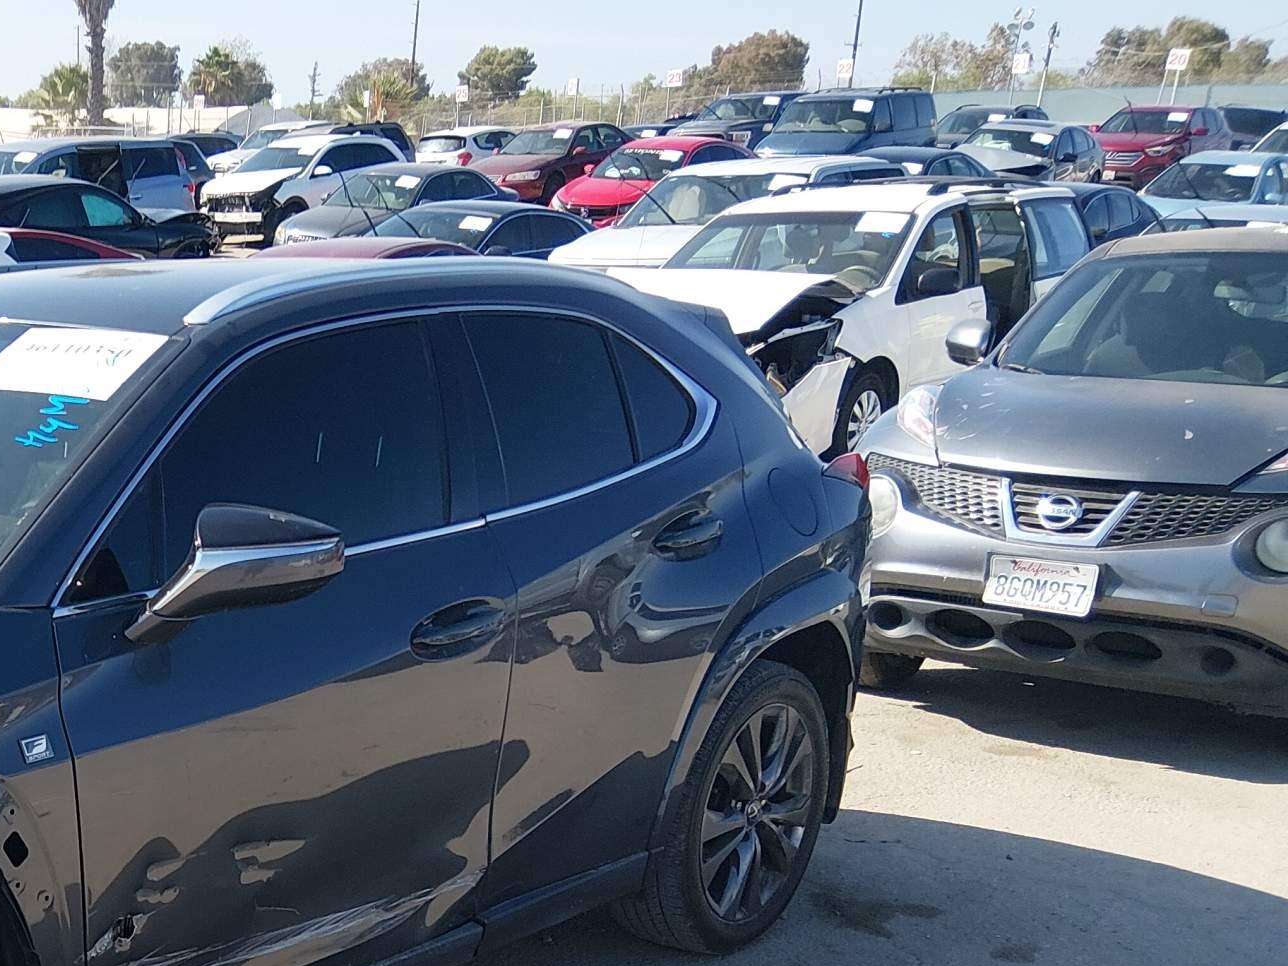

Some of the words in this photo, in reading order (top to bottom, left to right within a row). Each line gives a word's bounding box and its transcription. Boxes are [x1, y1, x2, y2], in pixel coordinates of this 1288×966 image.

[1169, 53, 1186, 65] 20
[838, 63, 852, 74] 22
[1013, 560, 1071, 577] California
[994, 574, 1088, 607] 8GQM957
[28, 751, 50, 761] SPORT
